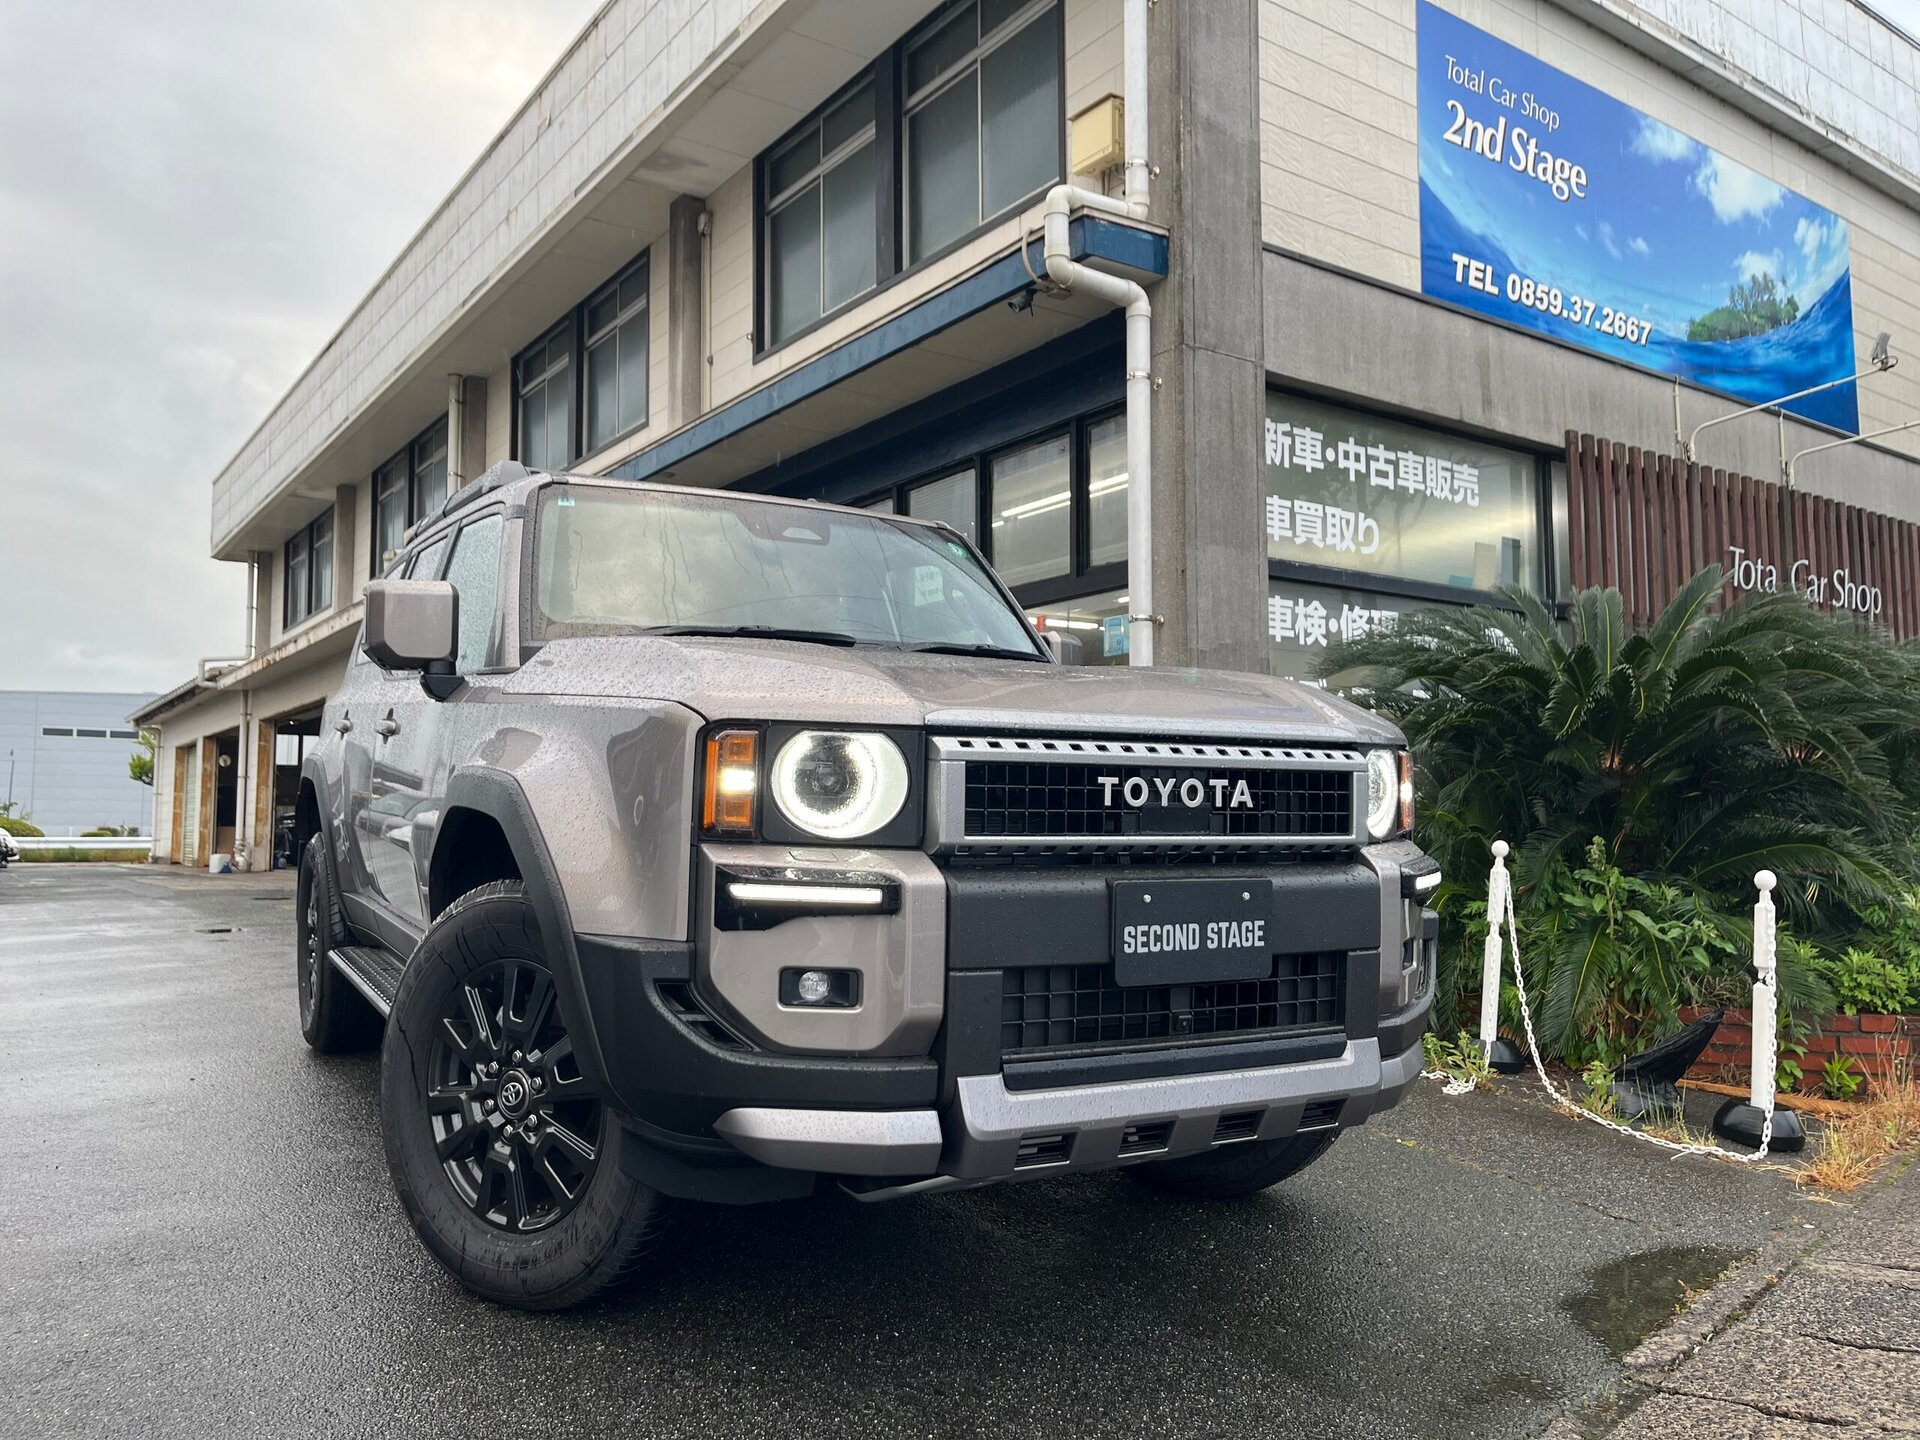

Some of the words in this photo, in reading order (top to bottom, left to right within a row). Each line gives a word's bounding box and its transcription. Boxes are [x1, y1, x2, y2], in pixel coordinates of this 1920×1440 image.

[1445, 54, 1484, 94] Total
[1489, 78, 1517, 109] Car
[1521, 92, 1560, 133] Shop
[1443, 99, 1507, 163] 2nd
[1509, 127, 1588, 202] Stage
[1452, 252, 1499, 296] TEL
[1506, 273, 1652, 347] 0859.37.2667
[1265, 417, 1480, 507] 新車・中古車販売
[1266, 495, 1380, 554] 車買取り
[1790, 559, 1828, 604] Car
[1832, 568, 1882, 622] Shop
[1097, 776, 1254, 809] TOYOTA
[1123, 923, 1200, 954] SECOND
[1207, 920, 1265, 949] STAGE
